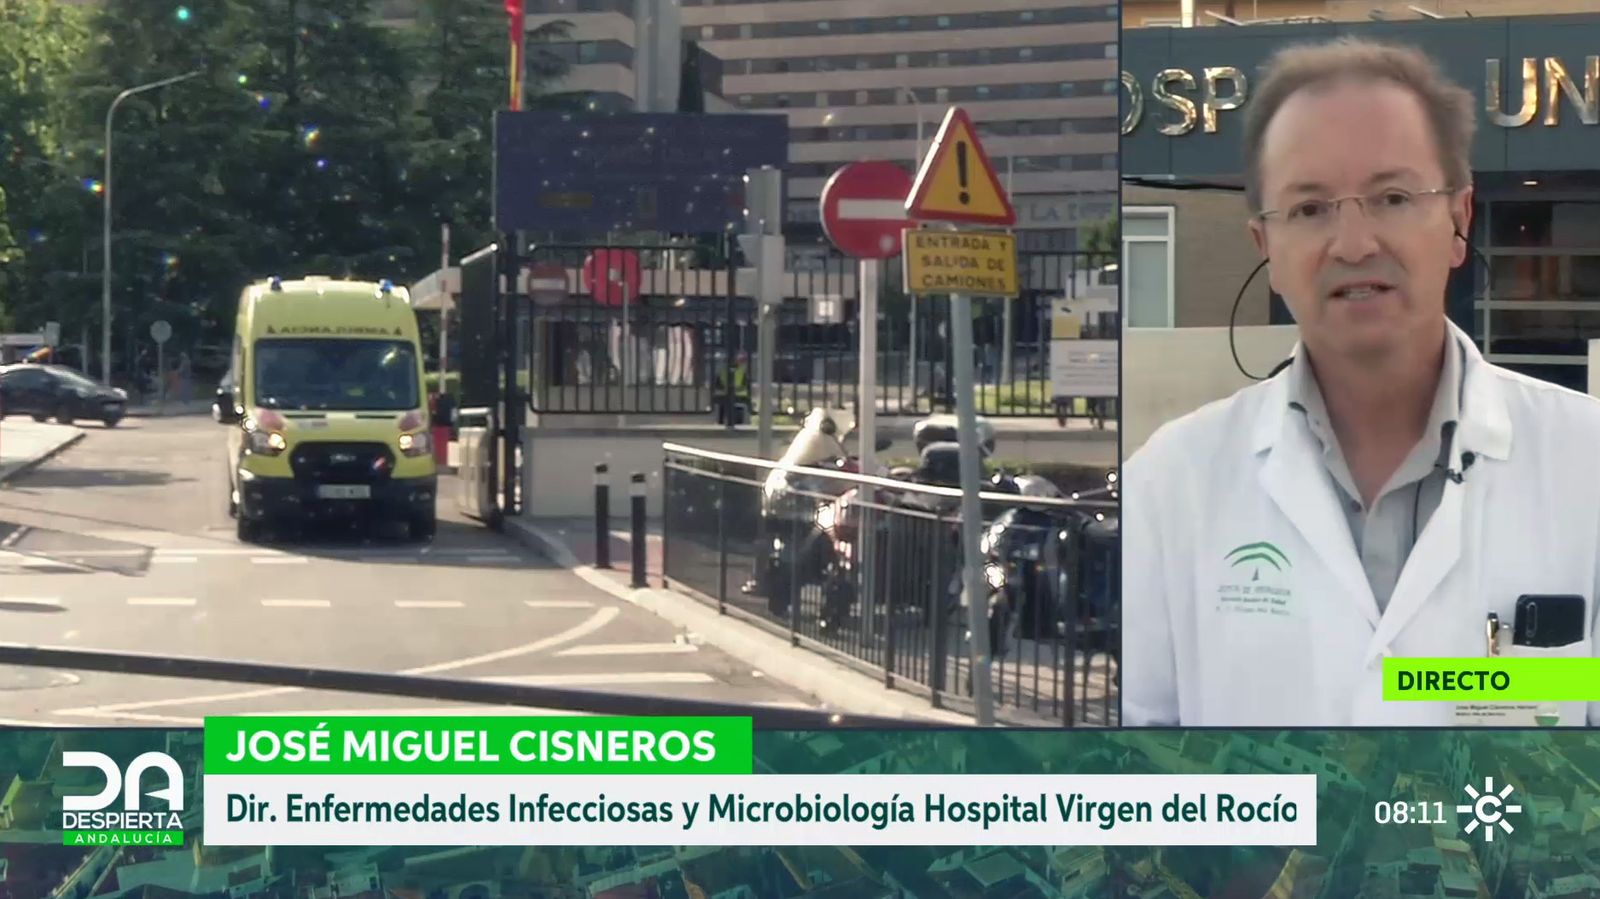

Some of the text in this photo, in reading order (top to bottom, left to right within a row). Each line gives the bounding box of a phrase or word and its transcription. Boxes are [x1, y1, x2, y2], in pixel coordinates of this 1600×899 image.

[916, 235, 1007, 251] ENTRADA Y
[921, 255, 1005, 271] SALIDA DE
[922, 274, 1006, 289] CAMIONES
